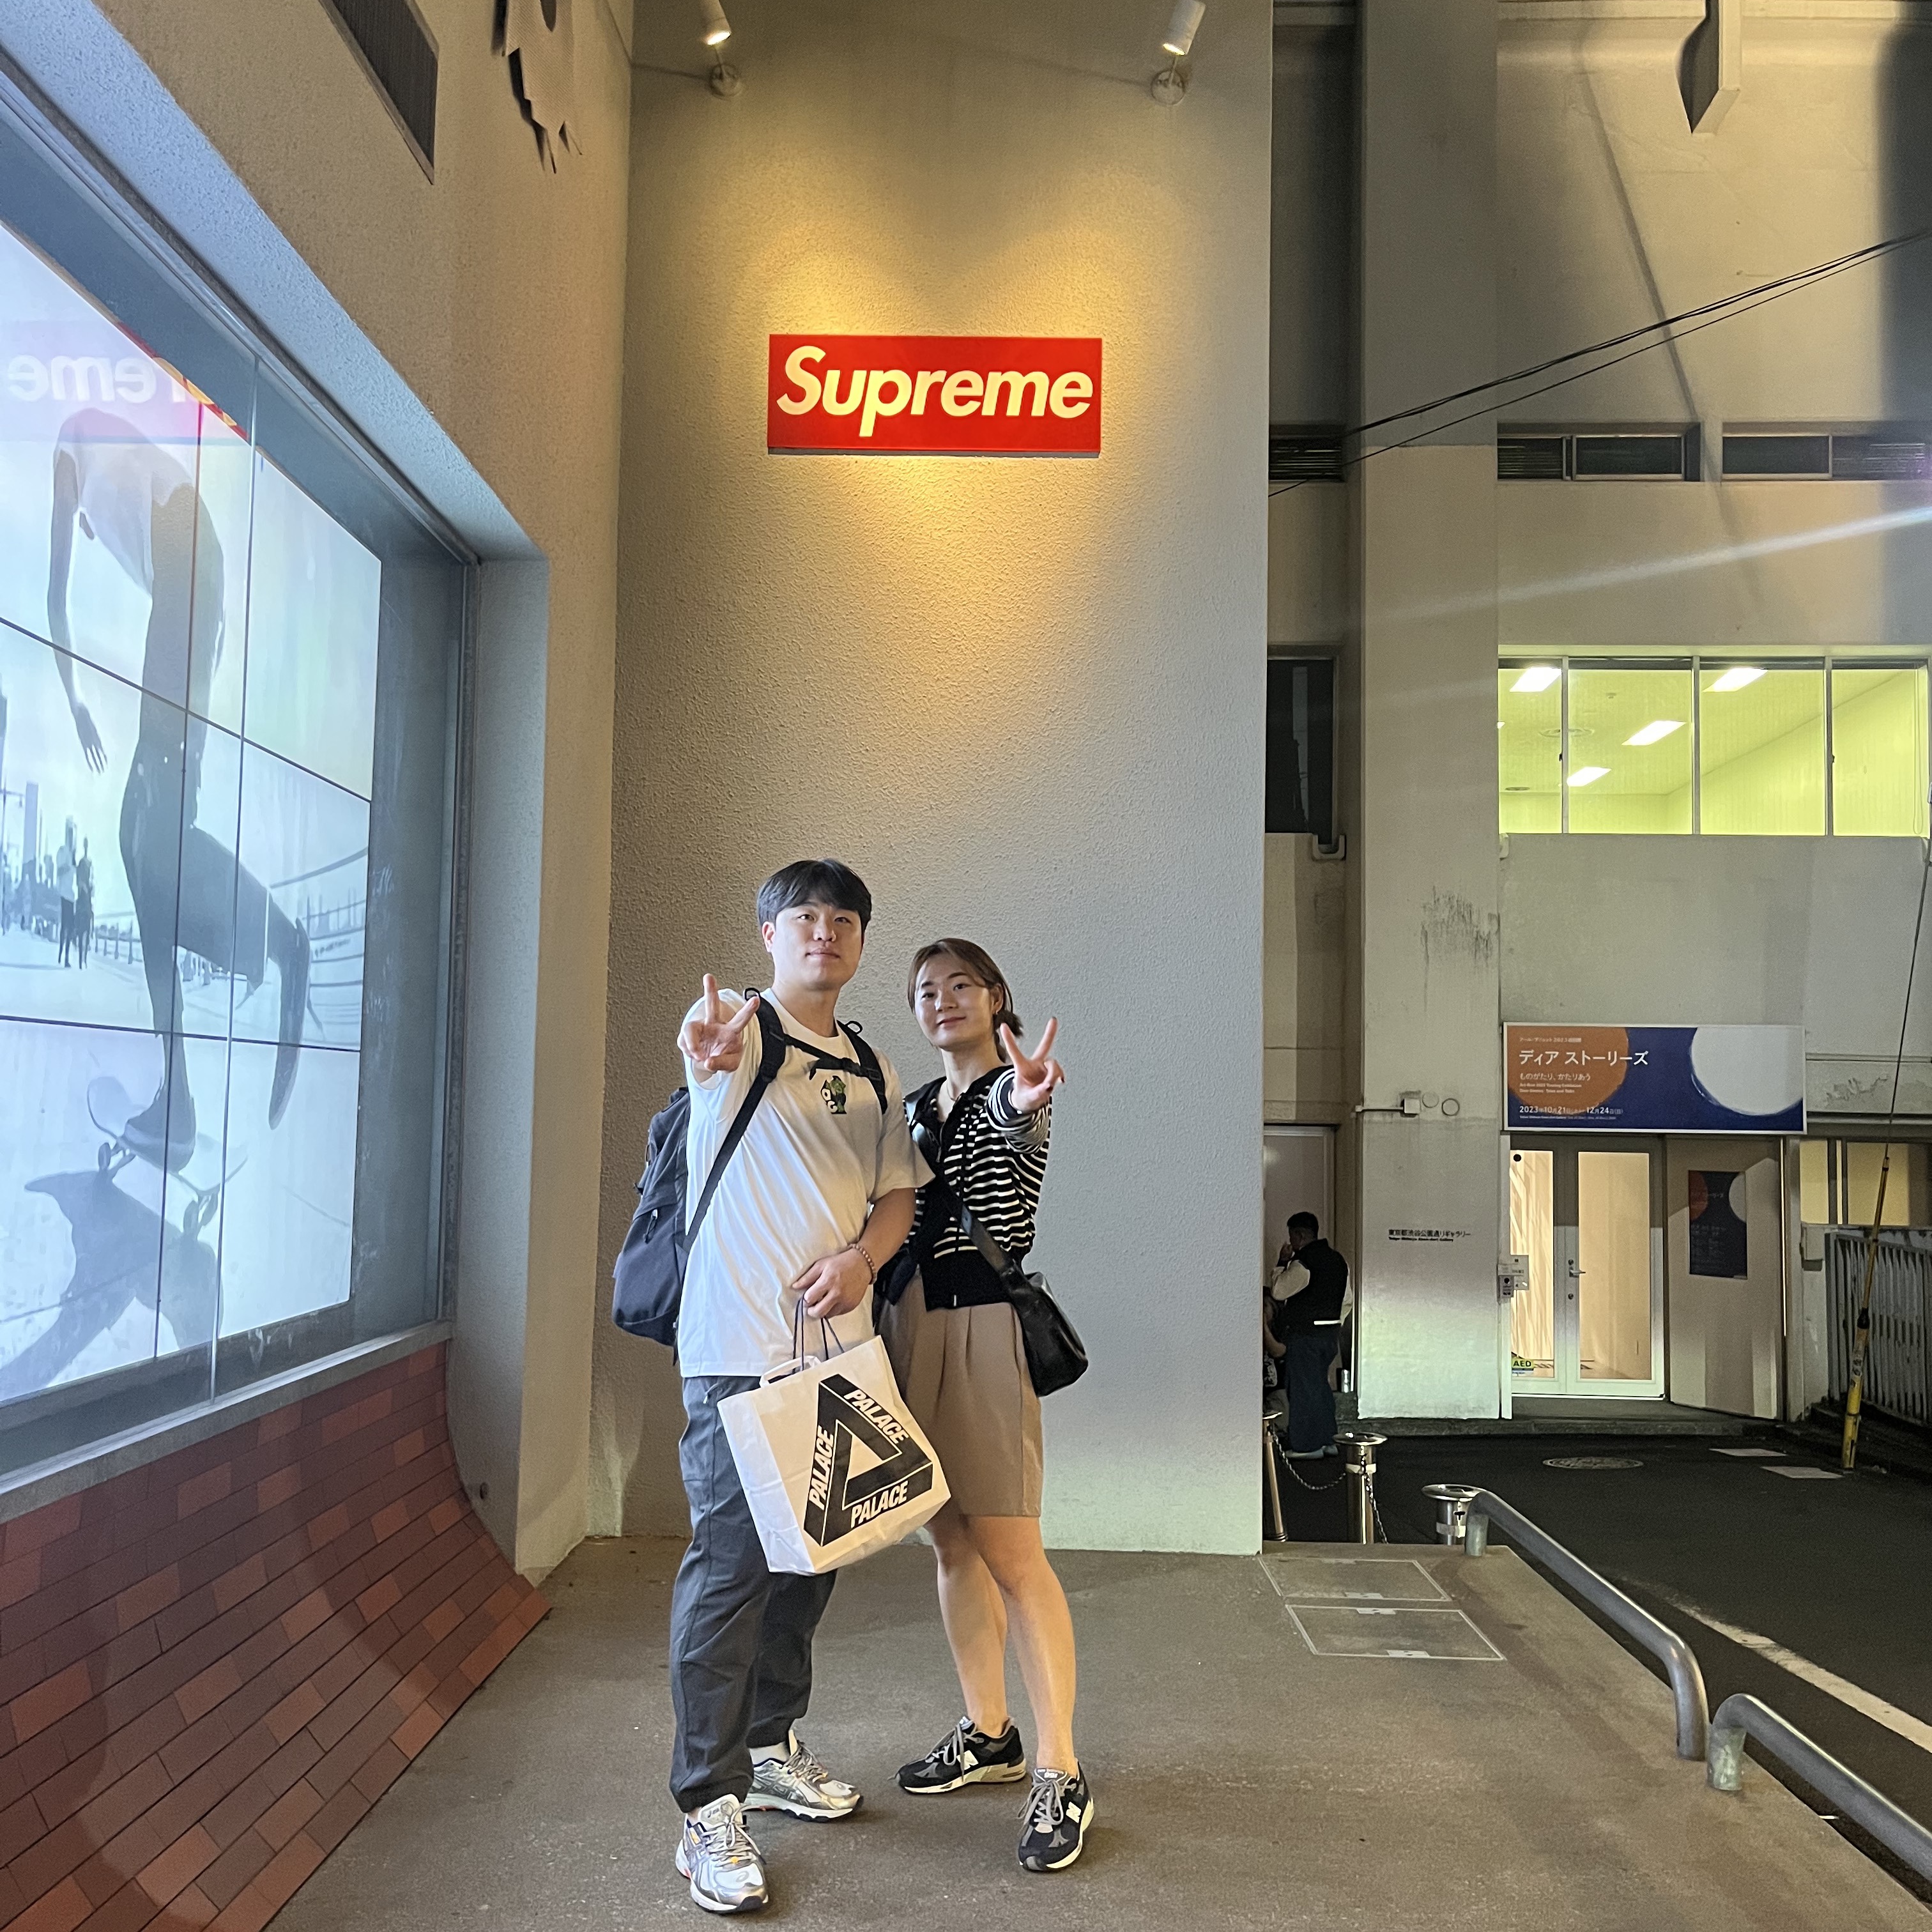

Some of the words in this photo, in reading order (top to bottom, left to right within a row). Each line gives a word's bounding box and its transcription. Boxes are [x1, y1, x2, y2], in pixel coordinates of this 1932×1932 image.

[776, 345, 1093, 437] Supreme
[1519, 1049, 1560, 1066] ディア
[1565, 1050, 1649, 1066] ストーリーズ
[843, 1389, 909, 1444] PALACE
[808, 1425, 834, 1510] PALACE
[850, 1480, 909, 1529] PALACE
[1066, 1802, 1082, 1823] N
